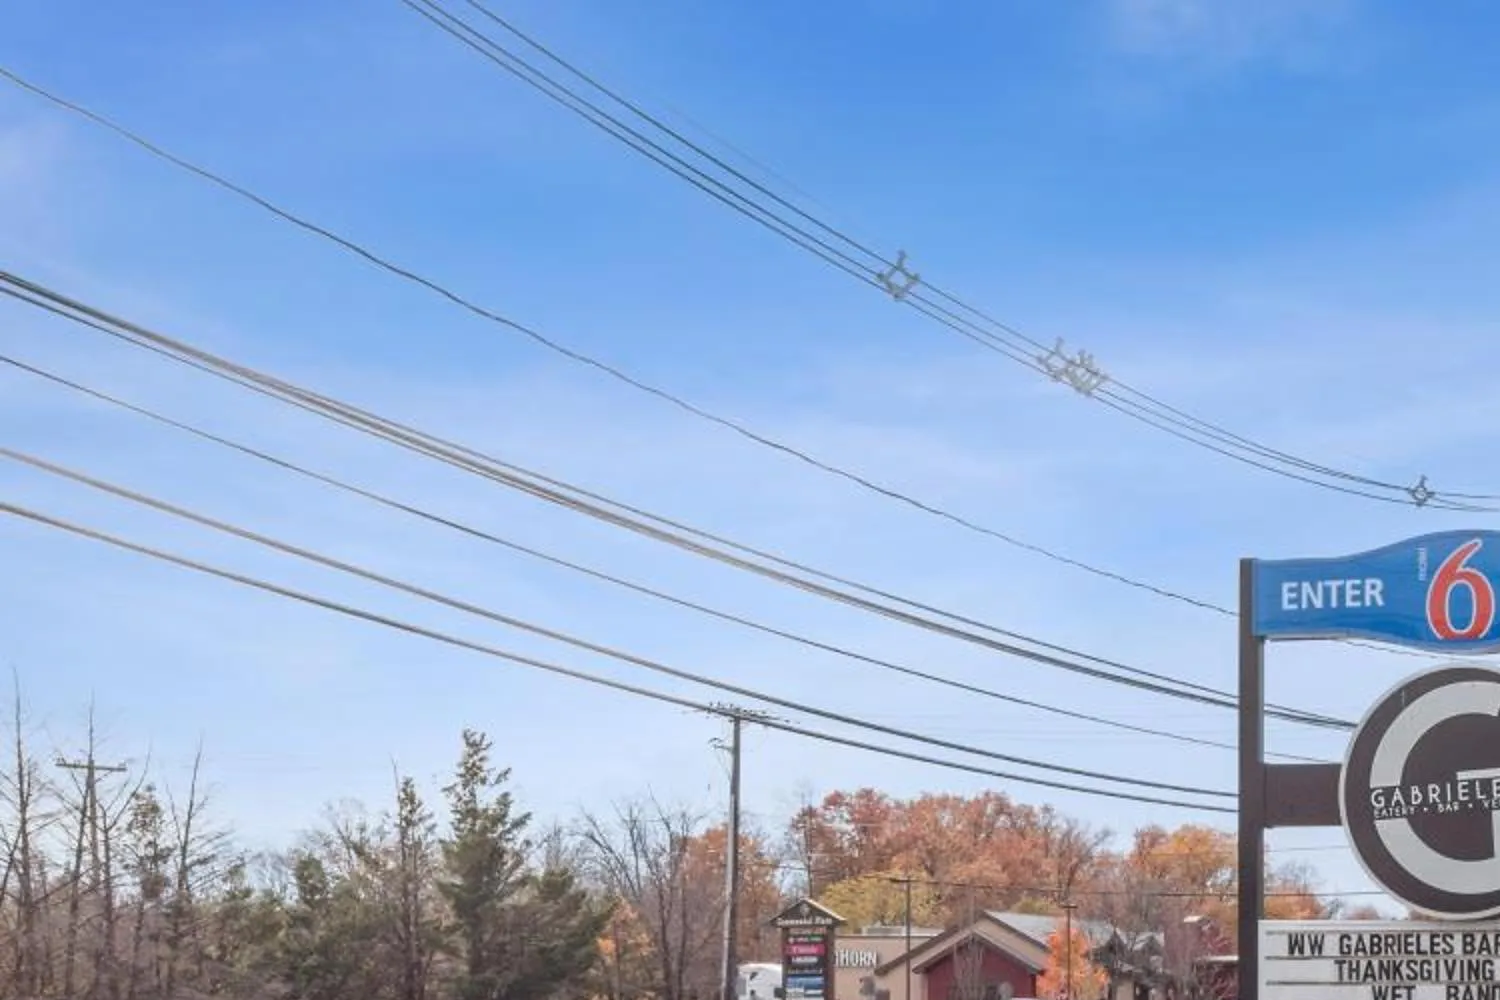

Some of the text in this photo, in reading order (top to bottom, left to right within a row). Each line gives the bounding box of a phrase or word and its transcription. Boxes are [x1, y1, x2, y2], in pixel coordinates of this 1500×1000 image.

[1281, 577, 1386, 611] ENTER
[1425, 538, 1496, 641] 6
[1437, 801, 1461, 813] BAR
[1338, 932, 1455, 956] GABRIELES
[1334, 958, 1495, 982] THANKSGIVING
